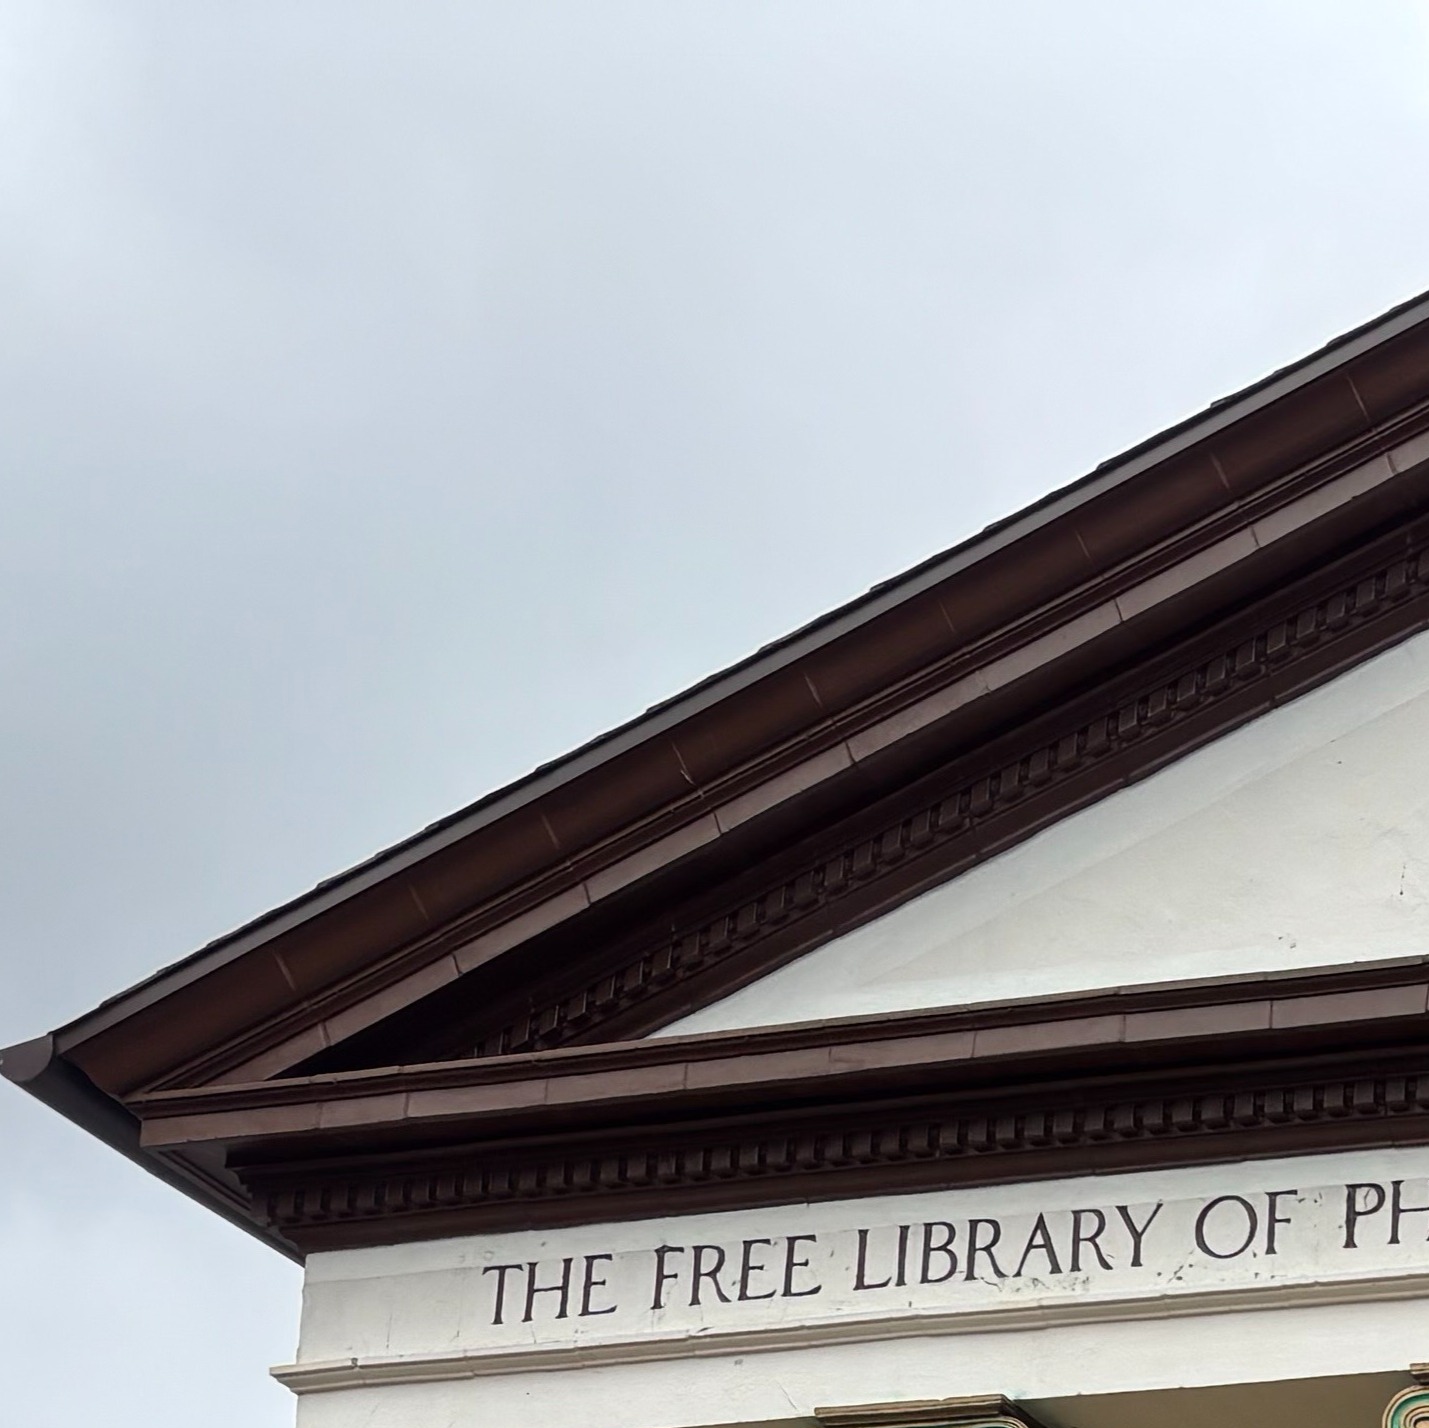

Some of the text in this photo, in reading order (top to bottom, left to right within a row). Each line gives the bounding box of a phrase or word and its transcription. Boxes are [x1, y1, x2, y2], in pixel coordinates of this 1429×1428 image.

[482, 1251, 616, 1325] THE
[650, 1233, 822, 1311] FREE
[853, 1202, 1163, 1293] LIBRARY
[1194, 1188, 1301, 1260] OF
